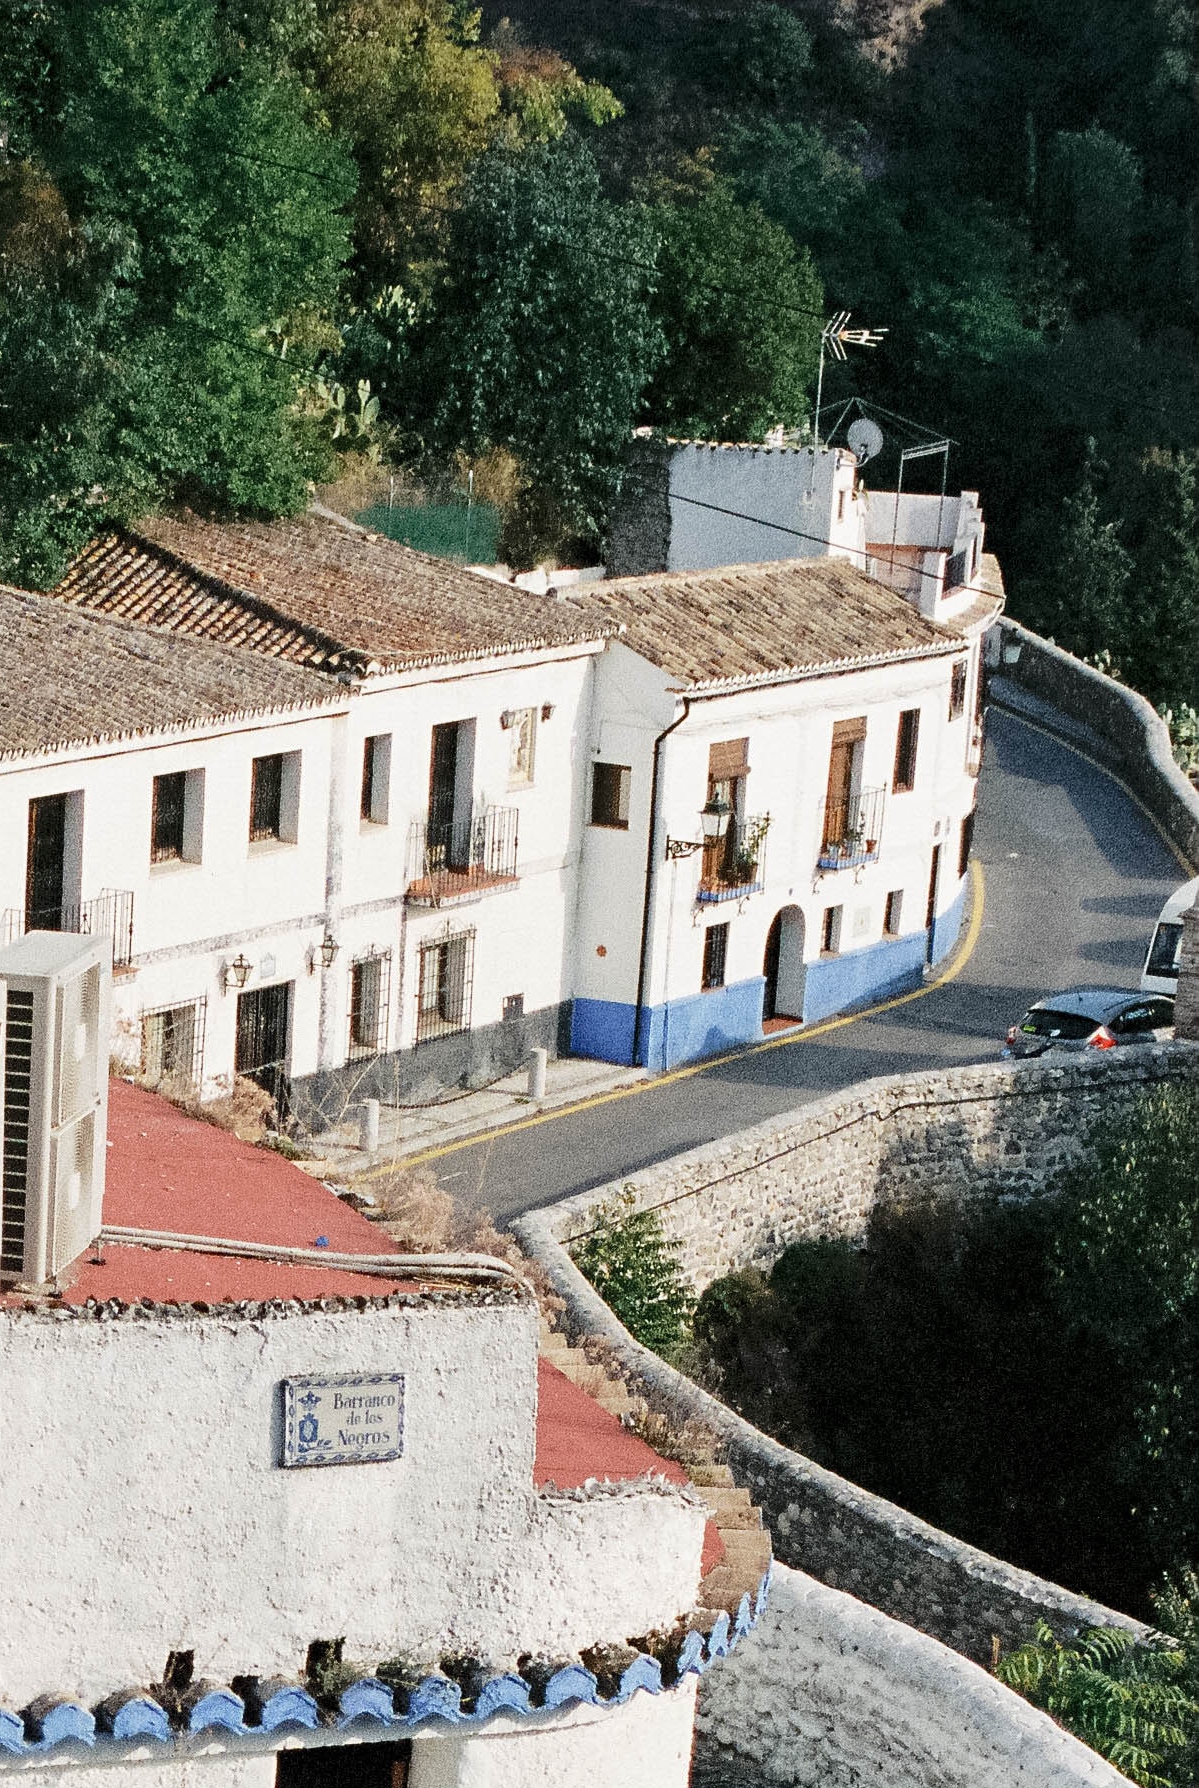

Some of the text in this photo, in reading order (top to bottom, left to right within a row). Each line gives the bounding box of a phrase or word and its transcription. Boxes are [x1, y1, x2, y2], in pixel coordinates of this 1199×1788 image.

[333, 1392, 396, 1410] Barranco
[346, 1409, 384, 1426] de los
[337, 1429, 390, 1450] Negros
